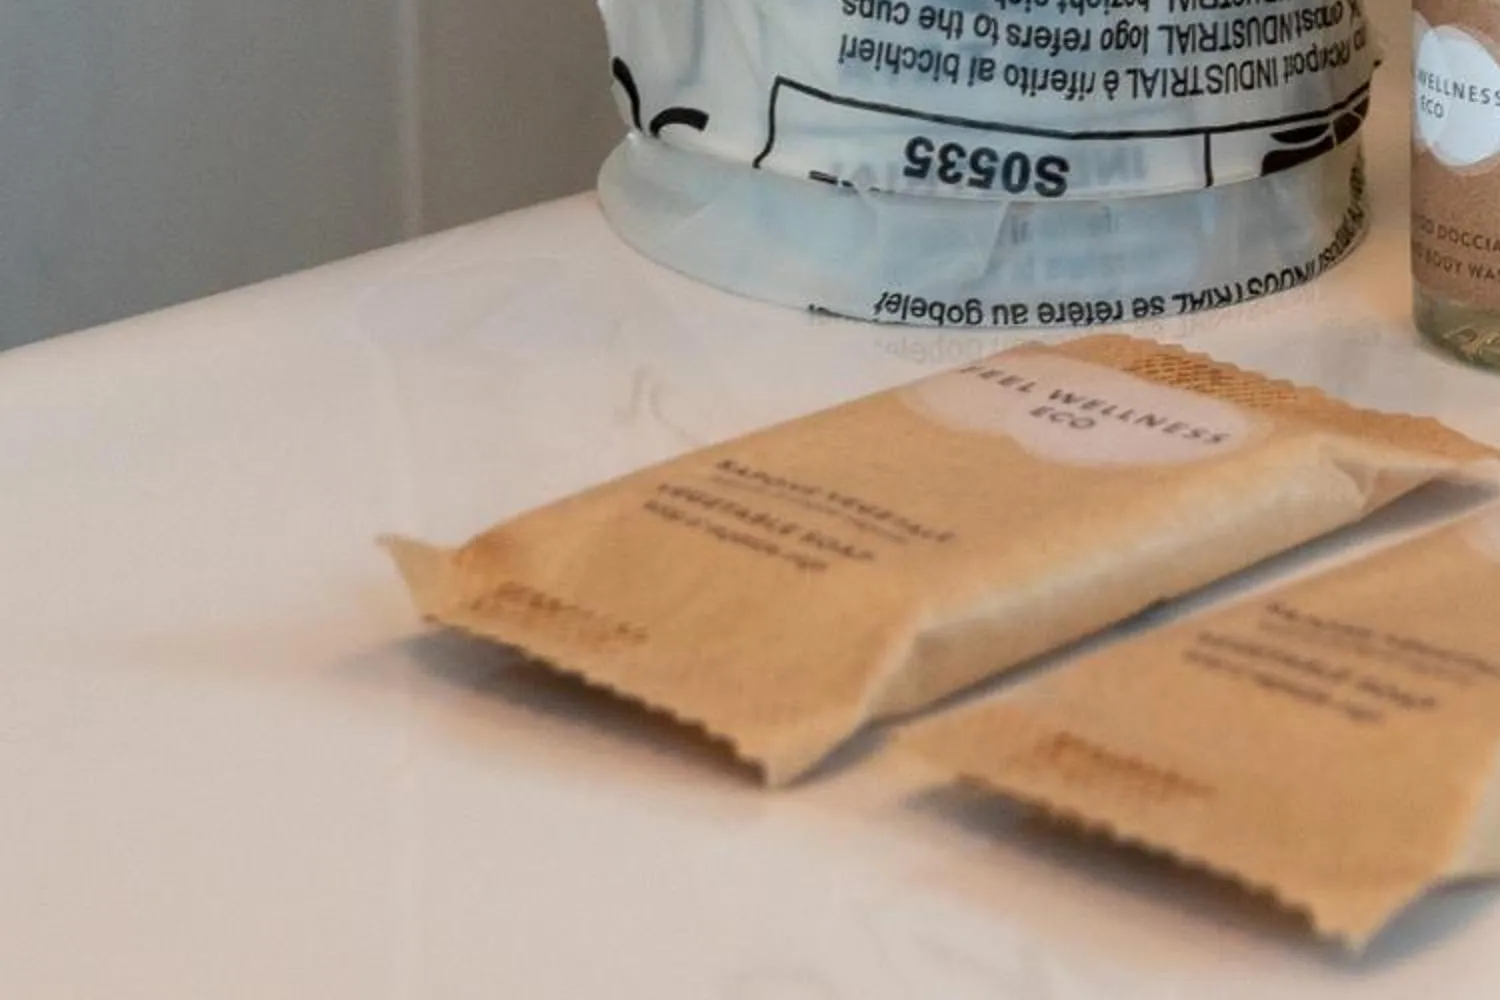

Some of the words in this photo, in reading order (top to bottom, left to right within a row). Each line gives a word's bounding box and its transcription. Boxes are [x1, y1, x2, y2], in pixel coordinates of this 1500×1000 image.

[917, 5, 965, 40] the
[972, 12, 1000, 46] to
[1004, 22, 1093, 58] refers
[1099, 18, 1150, 55] logo
[1157, 12, 1294, 56] NDUSTRIAL
[837, 33, 961, 85] bicchieri
[966, 56, 997, 88] ai
[1002, 63, 1097, 102] riferito
[1102, 69, 1120, 102] è
[1125, 56, 1279, 101] INDUSTRIAL
[902, 135, 1070, 199] S0535
[872, 292, 984, 327] gobelet
[991, 303, 1030, 327] au
[1131, 297, 1166, 320] se
[1028, 404, 1097, 430] ECO
[1048, 388, 1231, 445] WELLNESS
